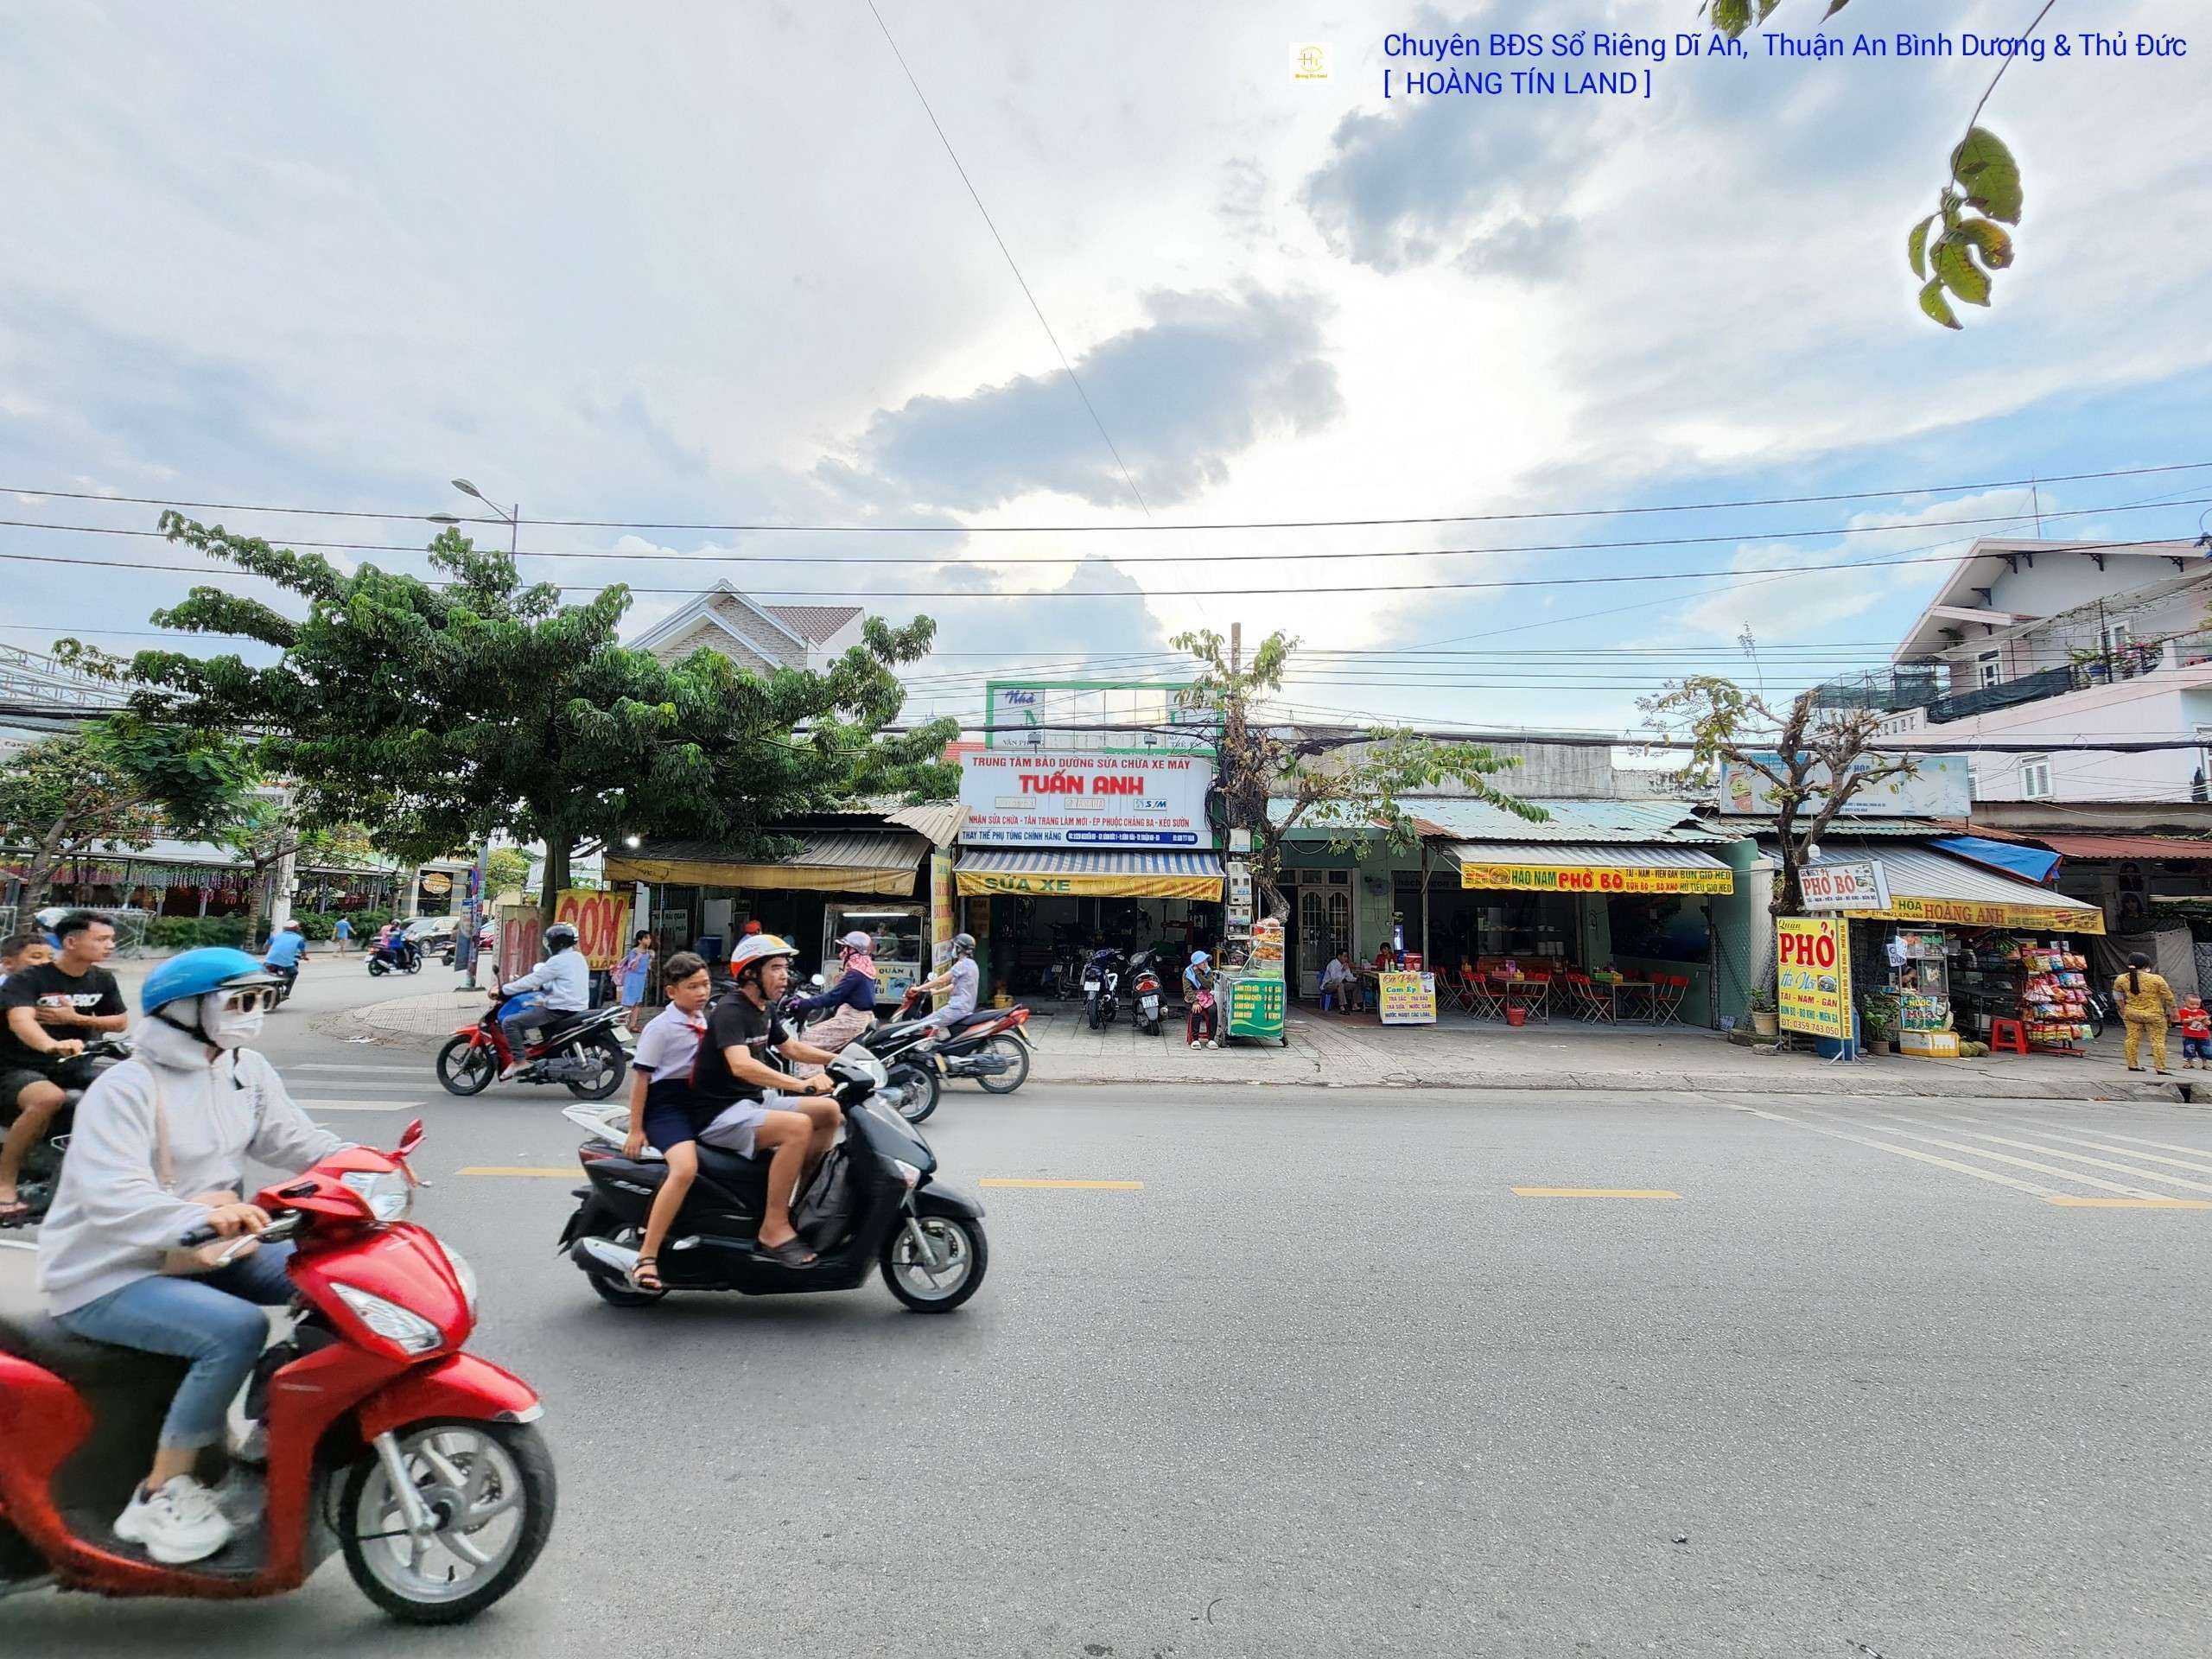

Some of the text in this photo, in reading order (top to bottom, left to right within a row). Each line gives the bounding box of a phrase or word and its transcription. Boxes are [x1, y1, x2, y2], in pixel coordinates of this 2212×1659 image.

[972, 755, 1191, 770] TRUNG TÂM BẢO DƯỠNG SỬA CHỮA XE MÁY
[1019, 769, 1144, 796] TUẤN ANH
[969, 815, 987, 826] NHẬN
[988, 813, 999, 825] SỬA
[1002, 815, 1019, 825] CHỮA
[1039, 817, 1059, 826] TRANG
[963, 831, 978, 840] THAY
[979, 830, 991, 840] THẾ
[992, 831, 1004, 842] PHỤ
[1007, 830, 1022, 841] TÙNG
[1024, 830, 1043, 841] CHÍNH
[1044, 830, 1061, 841] HÀNG
[983, 874, 1031, 892] SỬA
[1039, 878, 1071, 892] XE
[1534, 871, 1556, 887] NAM
[1558, 866, 1624, 890] PHỞ BÒ
[1802, 868, 1856, 896] PHỞ BÒ
[1898, 897, 1923, 912] HÓA
[1924, 901, 1972, 921] HOÀNG
[1977, 907, 2005, 924] ANH
[1779, 921, 1835, 969] PHỞ
